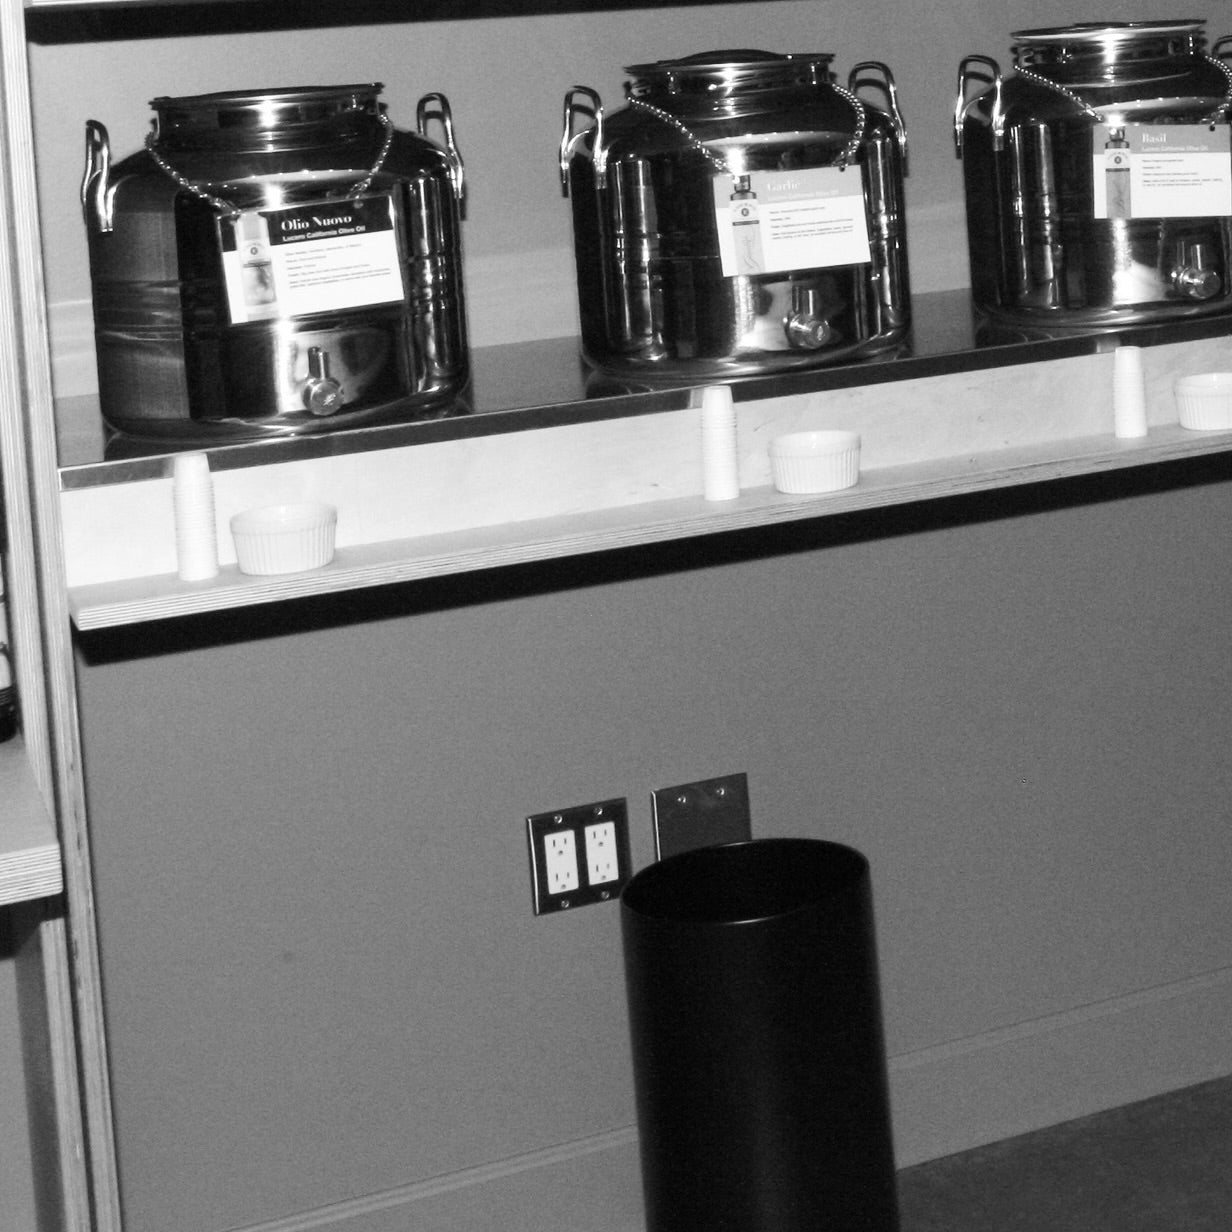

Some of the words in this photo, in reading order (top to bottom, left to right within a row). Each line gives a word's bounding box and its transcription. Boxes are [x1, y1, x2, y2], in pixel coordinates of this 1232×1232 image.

[1141, 132, 1168, 144] Basil
[281, 218, 310, 232] Olio
[311, 215, 353, 228] Nuovo
